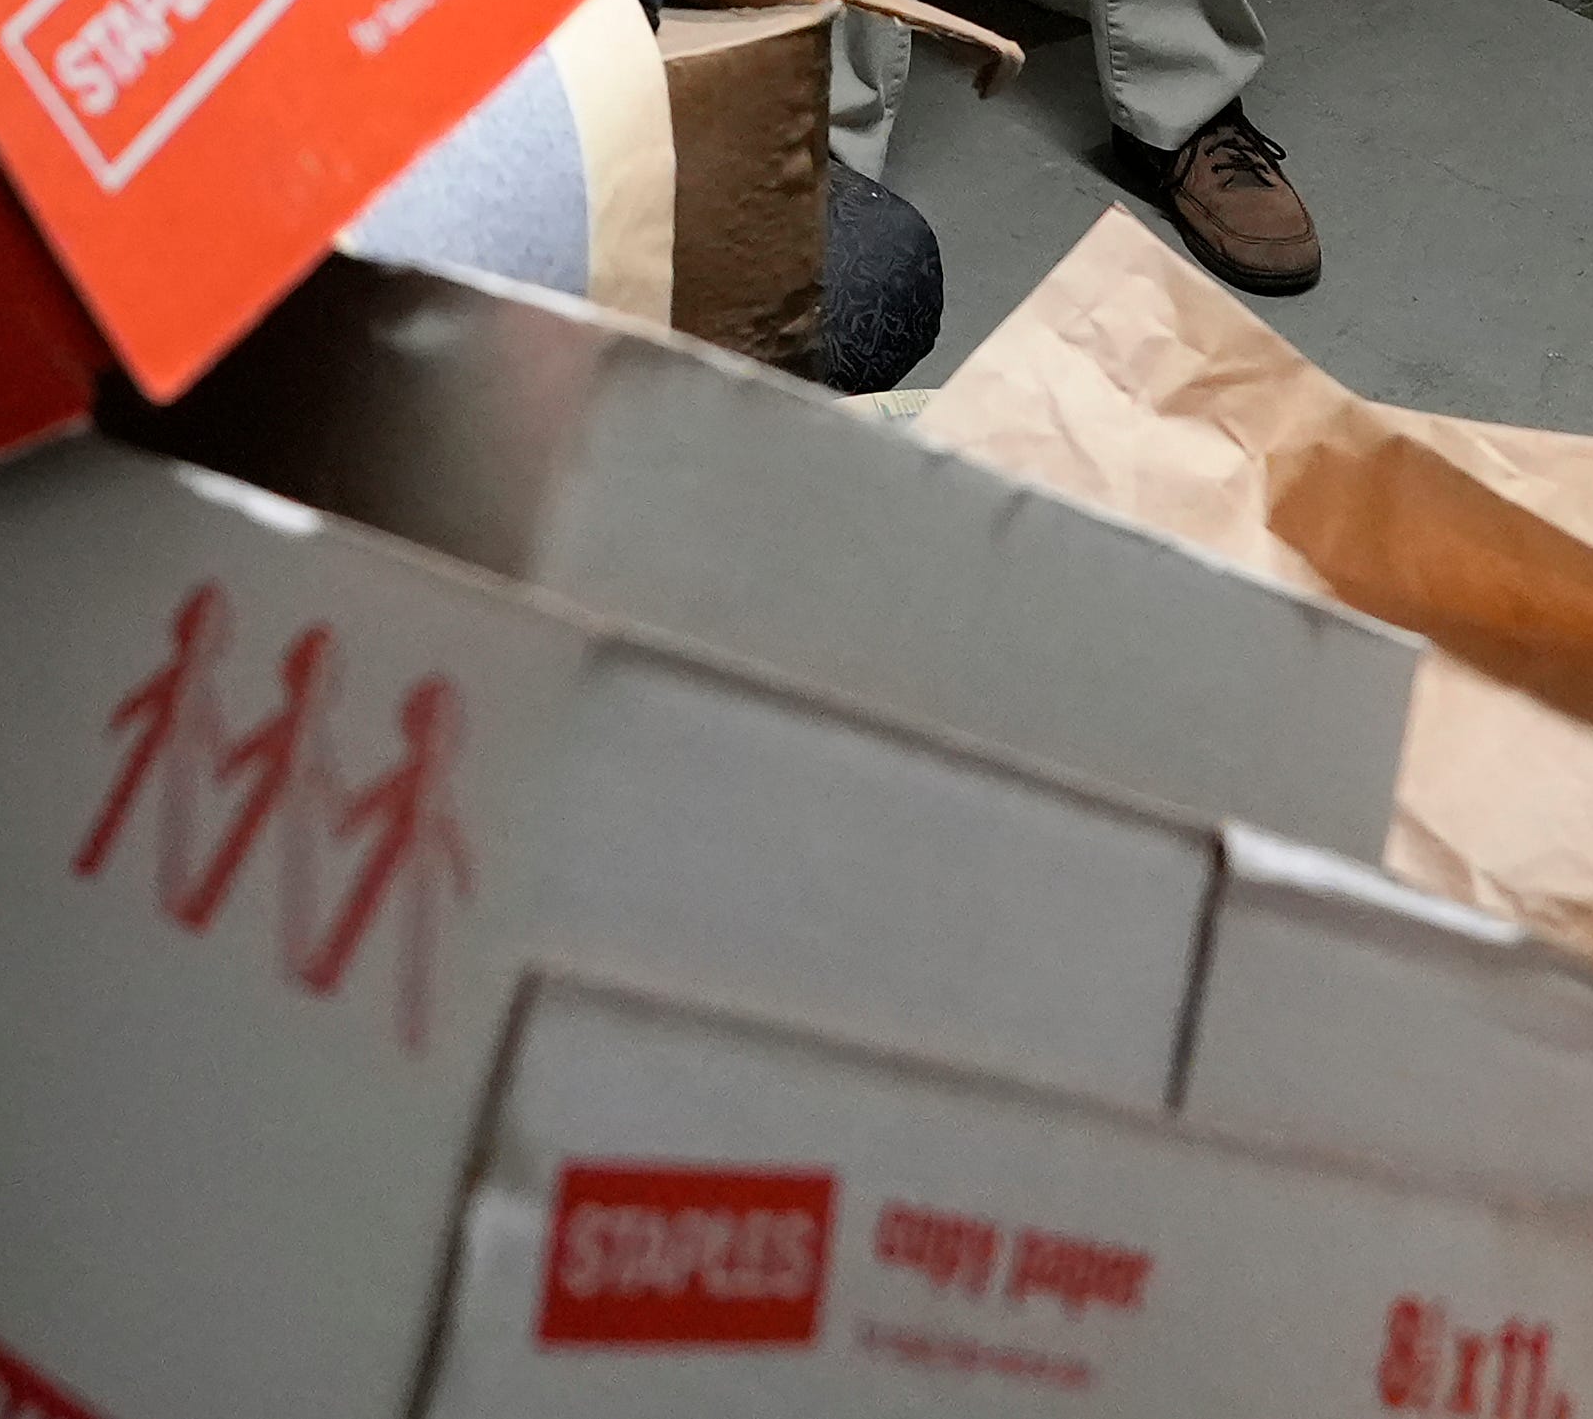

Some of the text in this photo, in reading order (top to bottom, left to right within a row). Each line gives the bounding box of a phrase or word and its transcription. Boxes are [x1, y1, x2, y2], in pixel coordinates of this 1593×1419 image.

[561, 1198, 1155, 1322] STAPLES copy paper
